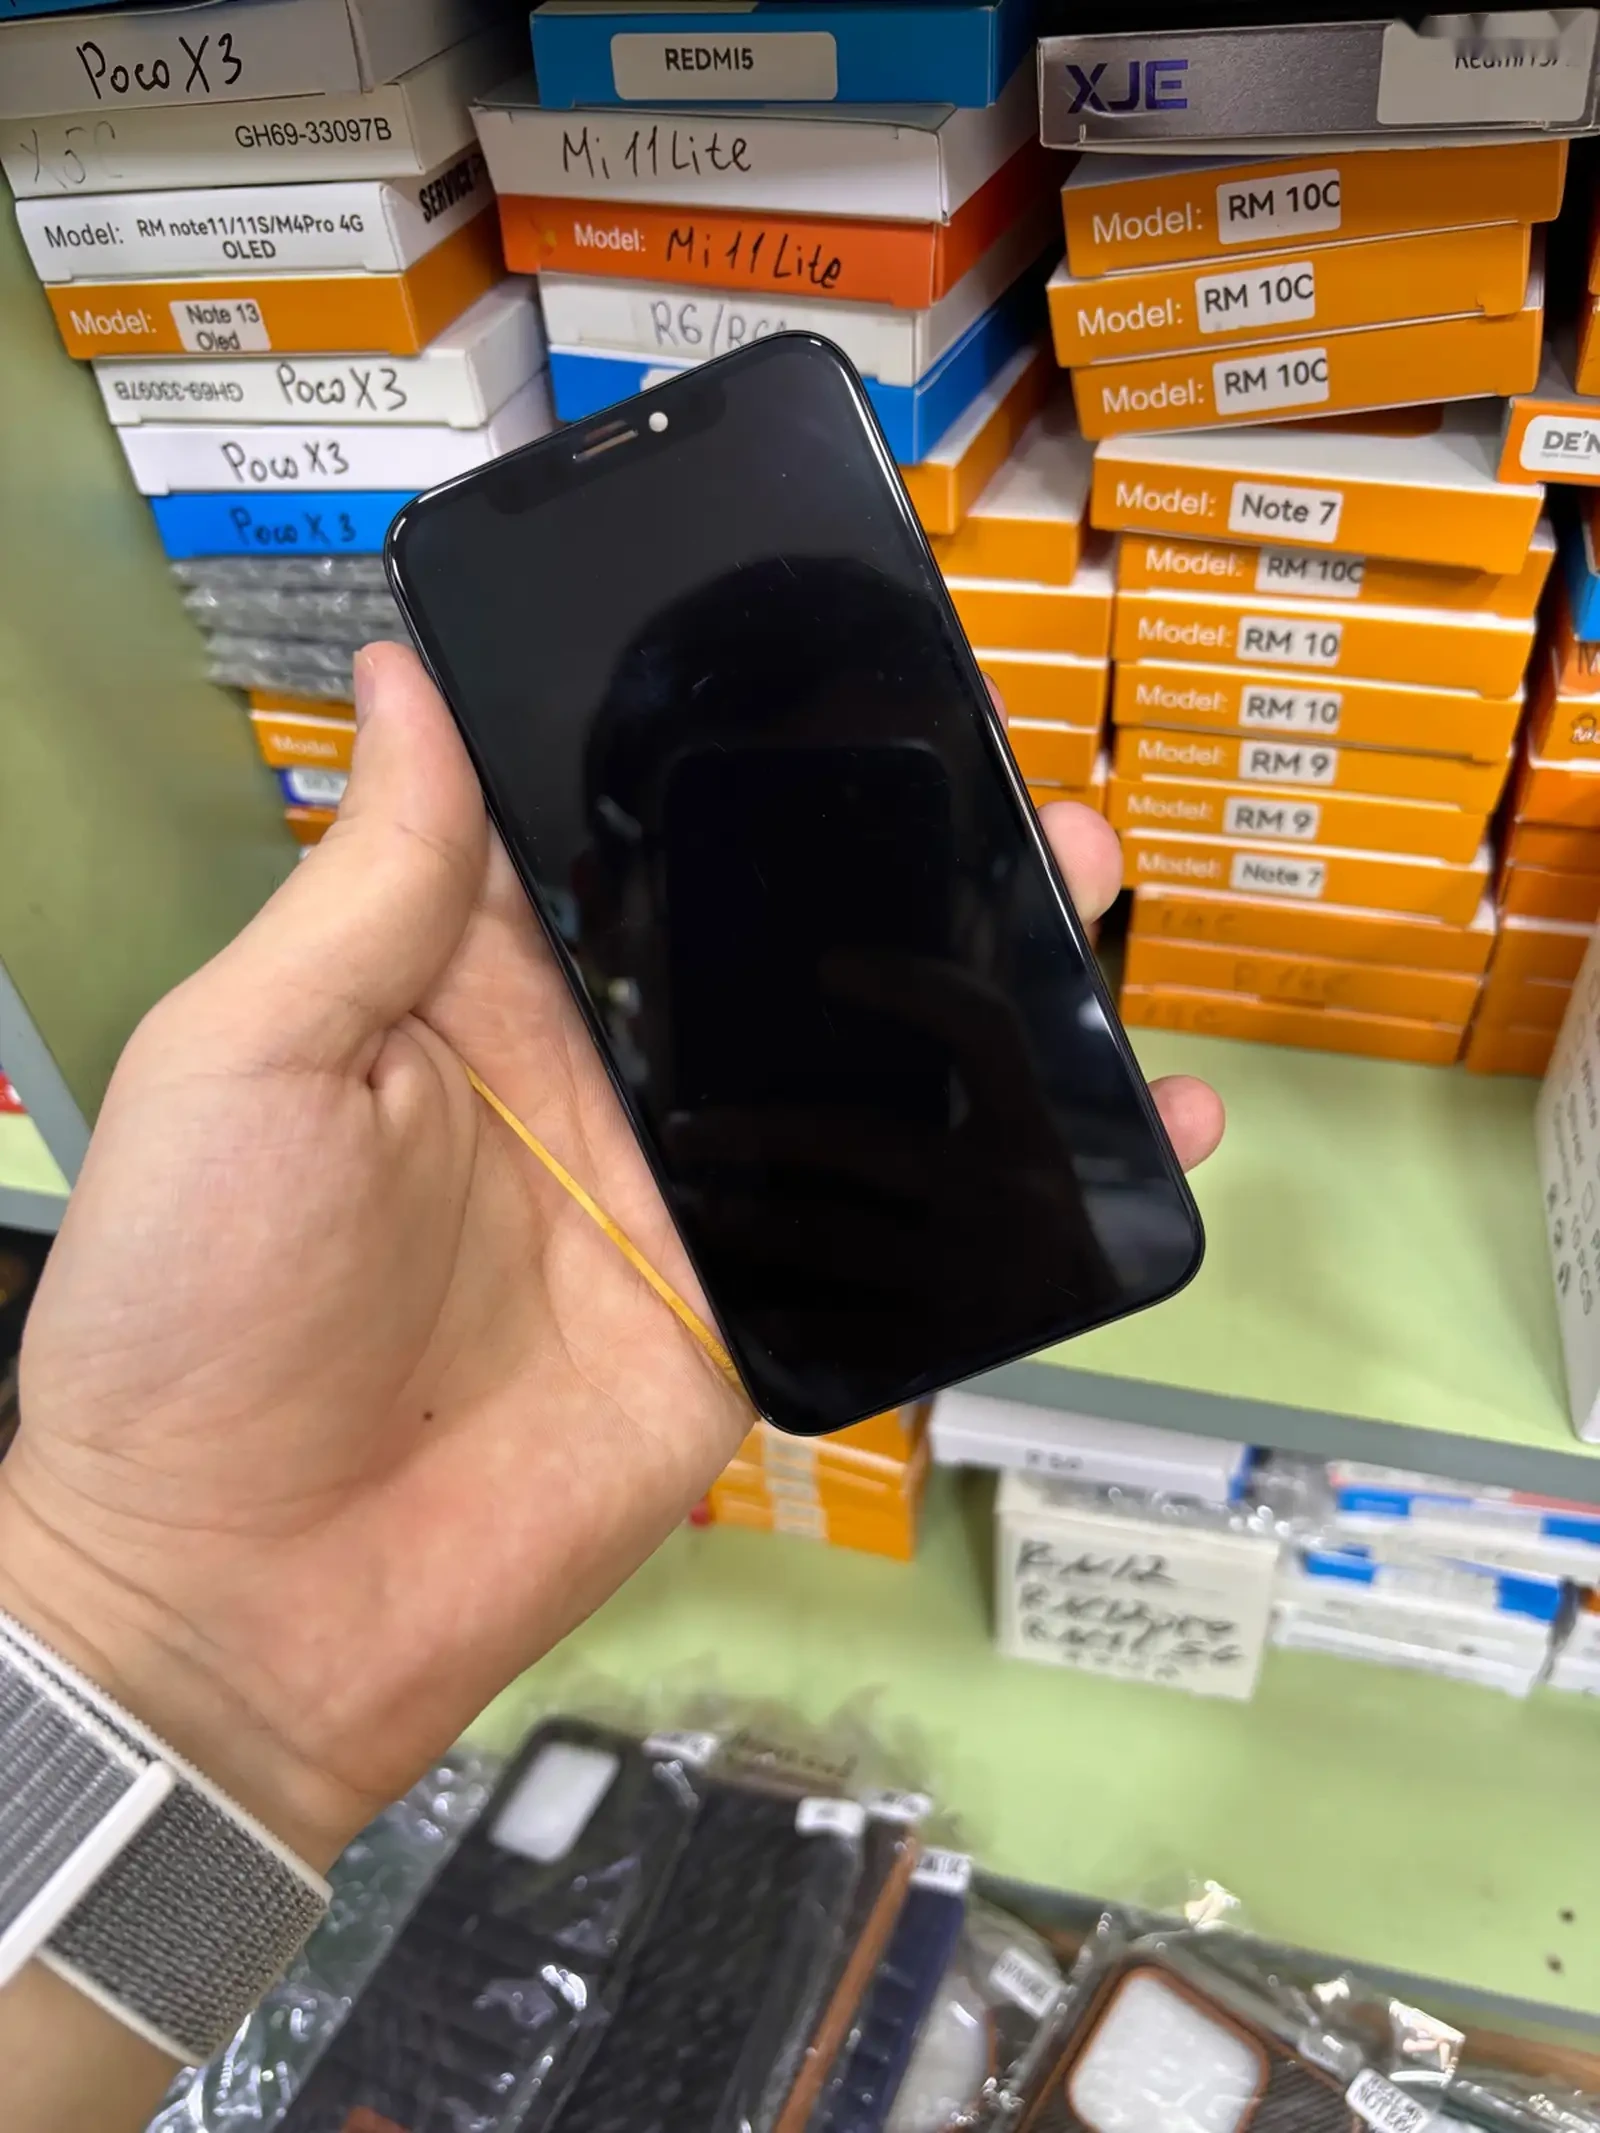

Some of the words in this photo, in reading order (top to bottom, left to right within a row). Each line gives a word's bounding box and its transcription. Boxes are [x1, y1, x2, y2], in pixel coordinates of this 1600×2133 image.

[77, 41, 170, 99] Poco
[664, 47, 754, 71] REDMI5
[1065, 60, 1189, 114] XJE
[235, 117, 392, 148] GH69-33097B
[671, 129, 752, 175] Lite
[44, 224, 125, 250] Model:
[136, 221, 167, 239] RM
[169, 215, 335, 238] note11/11S/M4Pro
[339, 214, 365, 235] 4G
[1092, 207, 1204, 245] Model:
[1227, 191, 1275, 222] RM
[1285, 179, 1340, 214] 10C
[222, 239, 277, 260] OLED
[574, 223, 647, 253] Model:
[772, 233, 843, 290] Lite
[69, 308, 157, 336] Model:
[187, 303, 232, 325] Note
[236, 302, 260, 323] 13
[1077, 299, 1183, 336] Model:
[1203, 284, 1247, 314] RM
[1258, 273, 1314, 304] 10C
[196, 331, 241, 351] Oled
[276, 362, 346, 405] Poco
[1102, 379, 1205, 414] Model:
[1223, 367, 1268, 395] RM
[1276, 358, 1328, 387] 10C
[1115, 482, 1216, 517] Model:
[1240, 492, 1310, 525] Note
[1319, 500, 1337, 526] 7
[1145, 546, 1243, 577] Model:
[1266, 557, 1308, 580] RM
[1318, 559, 1366, 583] 10C
[1137, 616, 1233, 648] Model:
[1244, 628, 1294, 654] RM
[1304, 631, 1339, 658] 10
[1136, 683, 1229, 713] Model:
[1245, 695, 1294, 721] RM
[1304, 698, 1339, 725] 10
[1137, 738, 1227, 769] Model:
[1250, 748, 1303, 777] RM
[1310, 753, 1330, 778] 9
[1234, 804, 1285, 832] RM
[1292, 810, 1313, 834] 9
[1242, 859, 1299, 884] Note
[1306, 867, 1323, 888] 7
